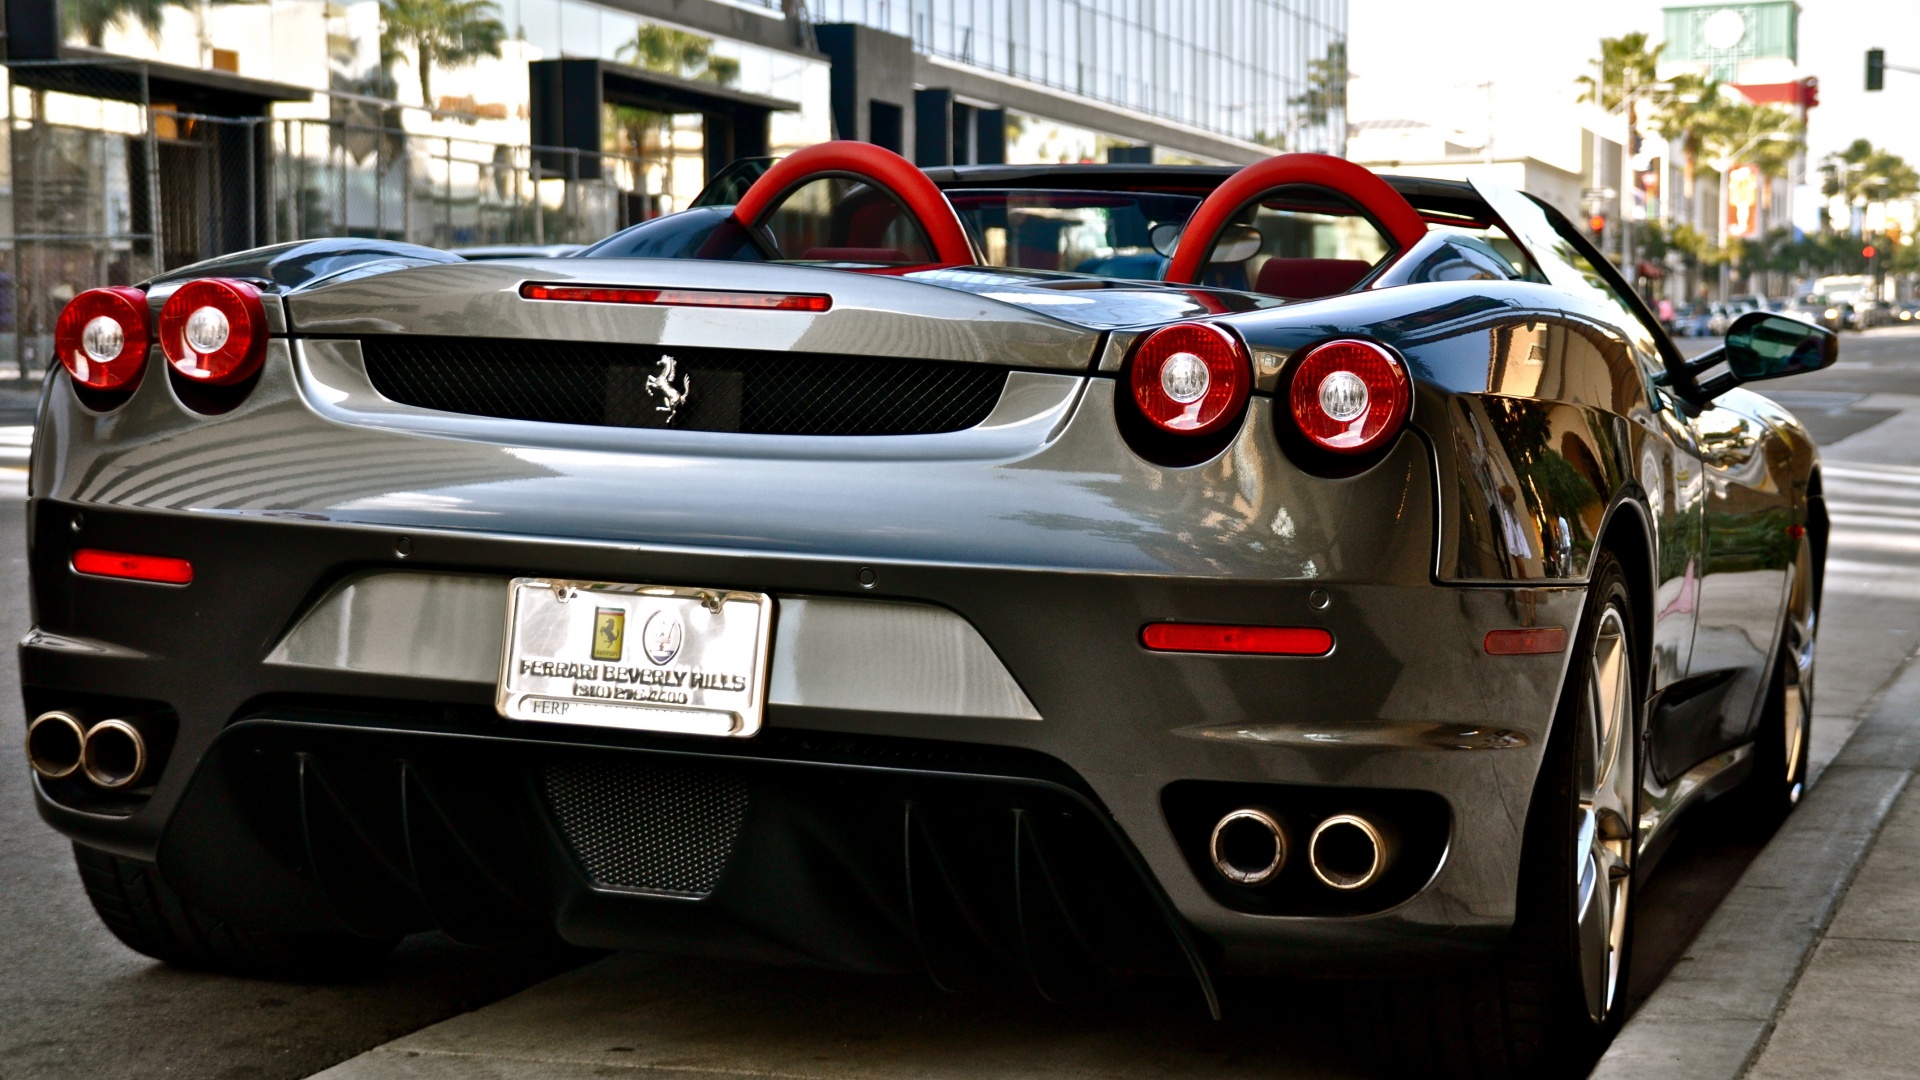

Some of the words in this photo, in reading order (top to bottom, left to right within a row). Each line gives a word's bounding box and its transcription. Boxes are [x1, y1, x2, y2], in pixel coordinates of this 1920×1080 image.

[519, 660, 599, 681] FERRARI
[602, 664, 688, 688] BEVERLY
[689, 670, 746, 693] HILLS
